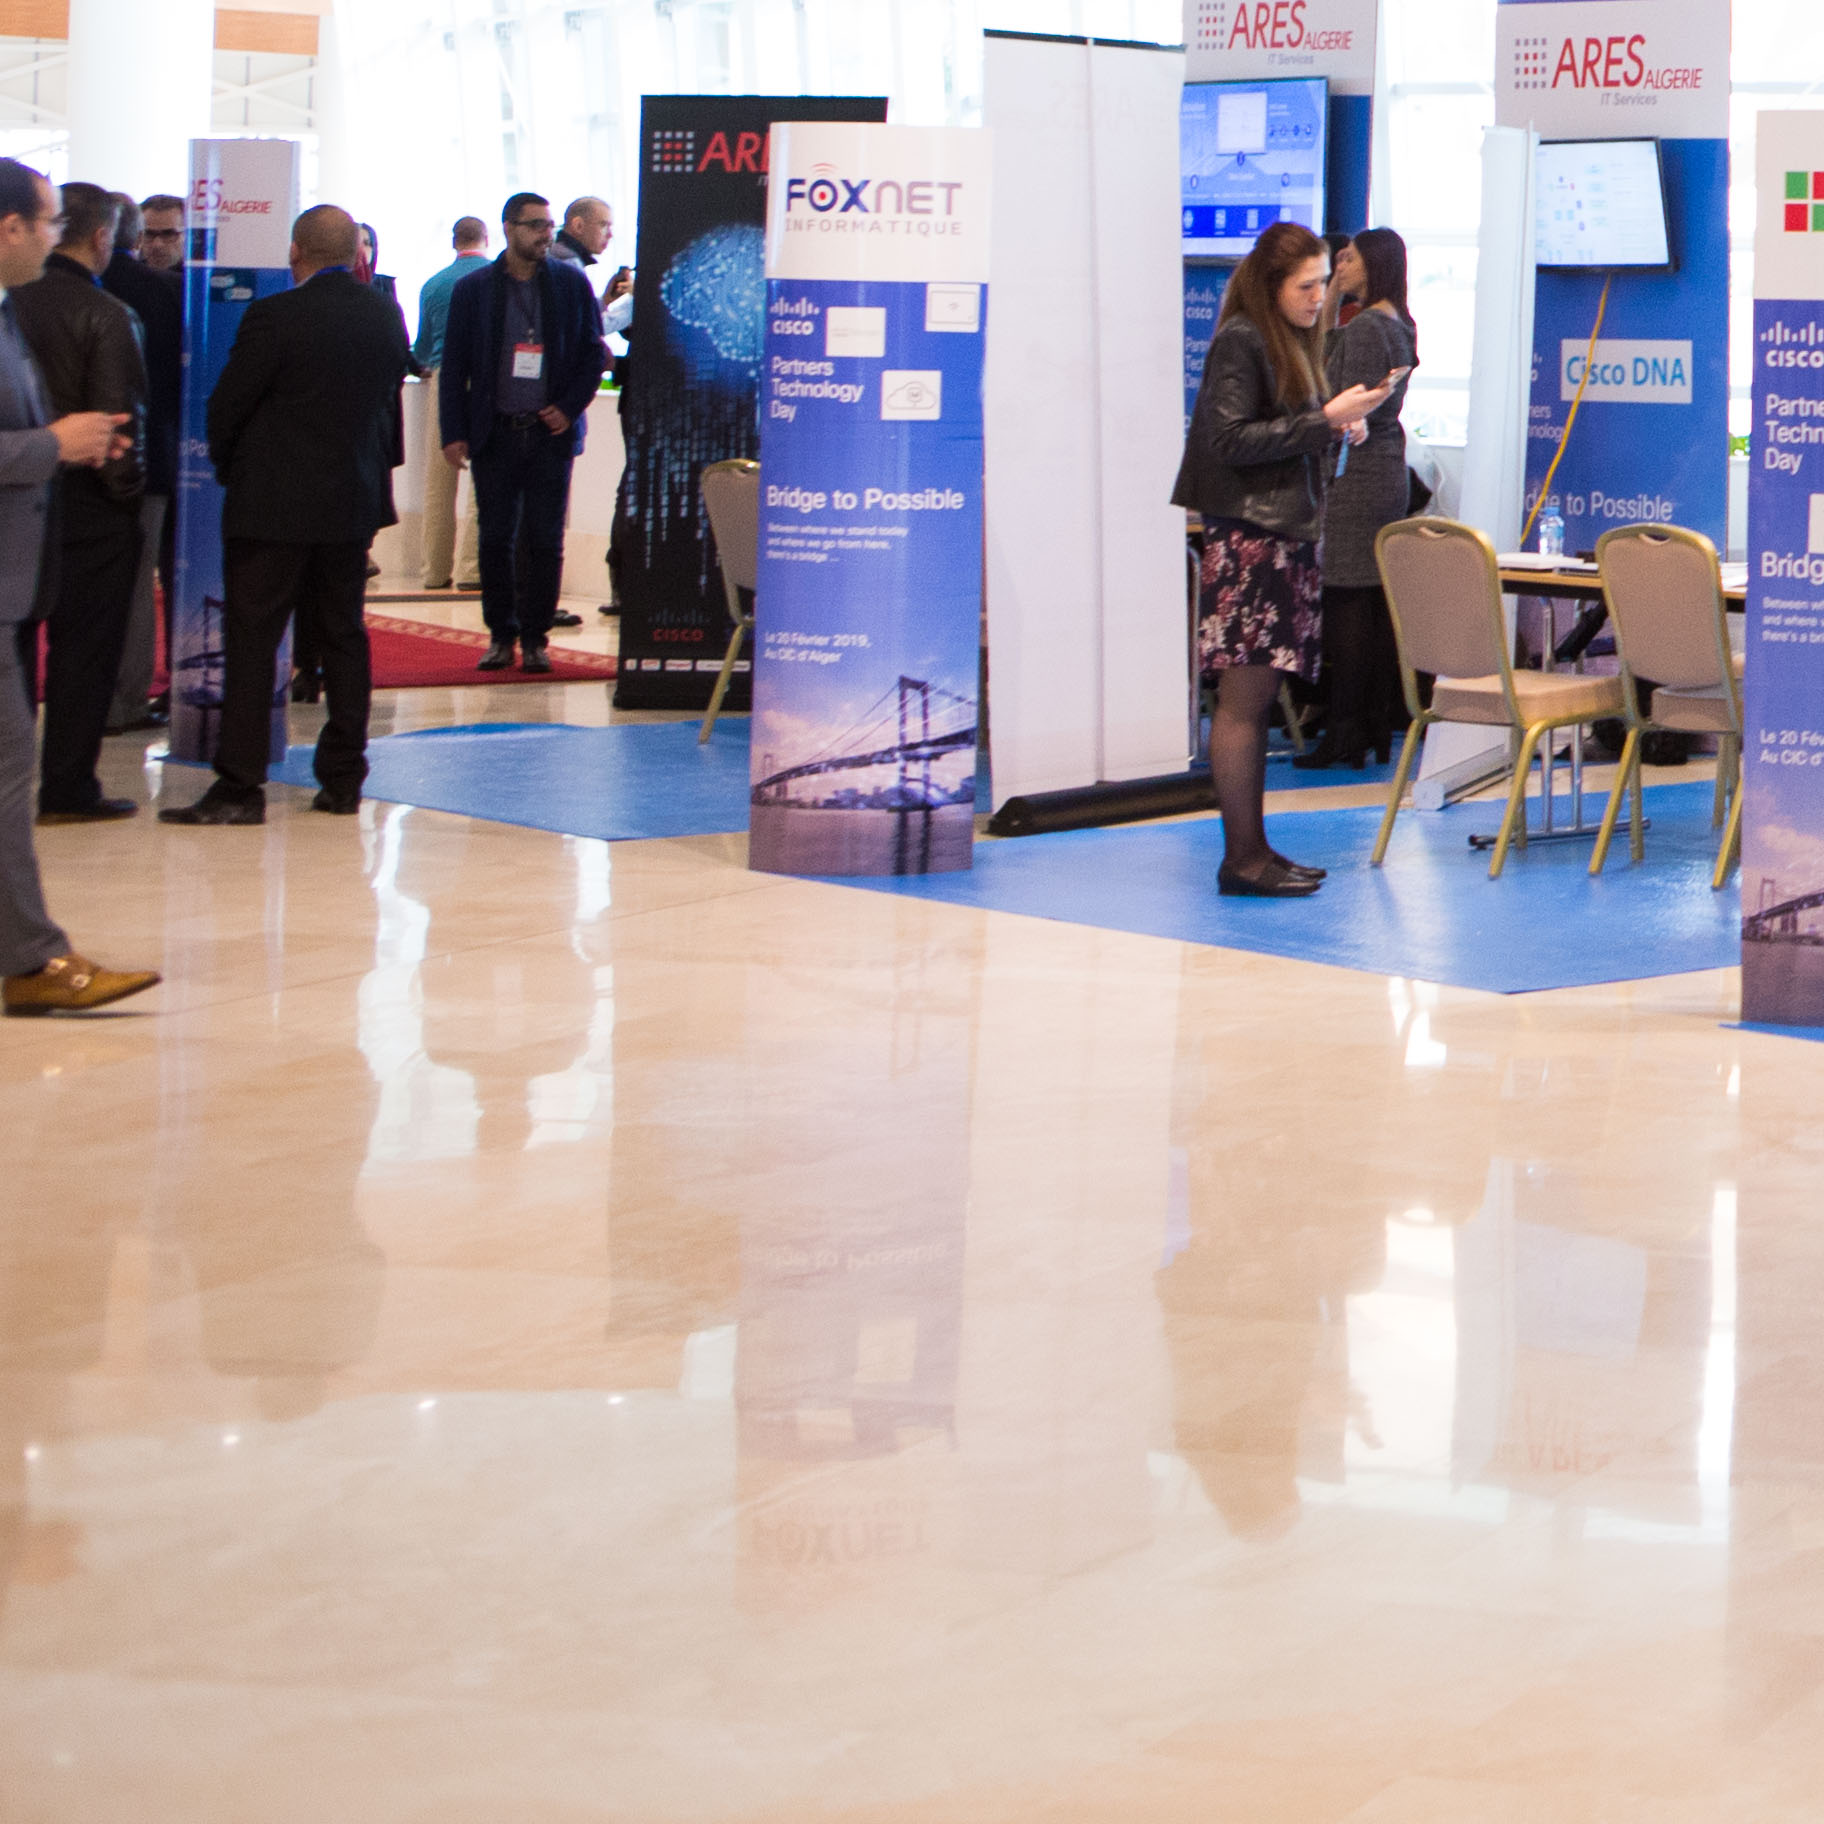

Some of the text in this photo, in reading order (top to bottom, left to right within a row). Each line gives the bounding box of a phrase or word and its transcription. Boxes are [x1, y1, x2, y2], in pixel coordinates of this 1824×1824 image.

[1303, 30, 1353, 51] ALGERIE
[1279, 54, 1314, 65] Services
[1551, 34, 1703, 90] ARES ALGERIE
[1614, 92, 1658, 106] Services
[785, 218, 963, 235] INFORMATIQUE
[770, 356, 834, 376] Partners
[1566, 356, 1687, 387] Cisco DNA
[770, 378, 864, 404] Technology
[770, 400, 797, 423] Day
[1764, 448, 1804, 476] Day
[766, 484, 965, 514] Bridge to Possible
[1566, 490, 1673, 521] to Possible
[1762, 596, 1809, 611] Between
[1784, 615, 1818, 627] where
[833, 634, 873, 649] 2019,
[1760, 729, 1778, 744] Le
[1779, 730, 1798, 745] 20
[1759, 749, 1778, 764] Au
[1779, 750, 1808, 766] CIC
